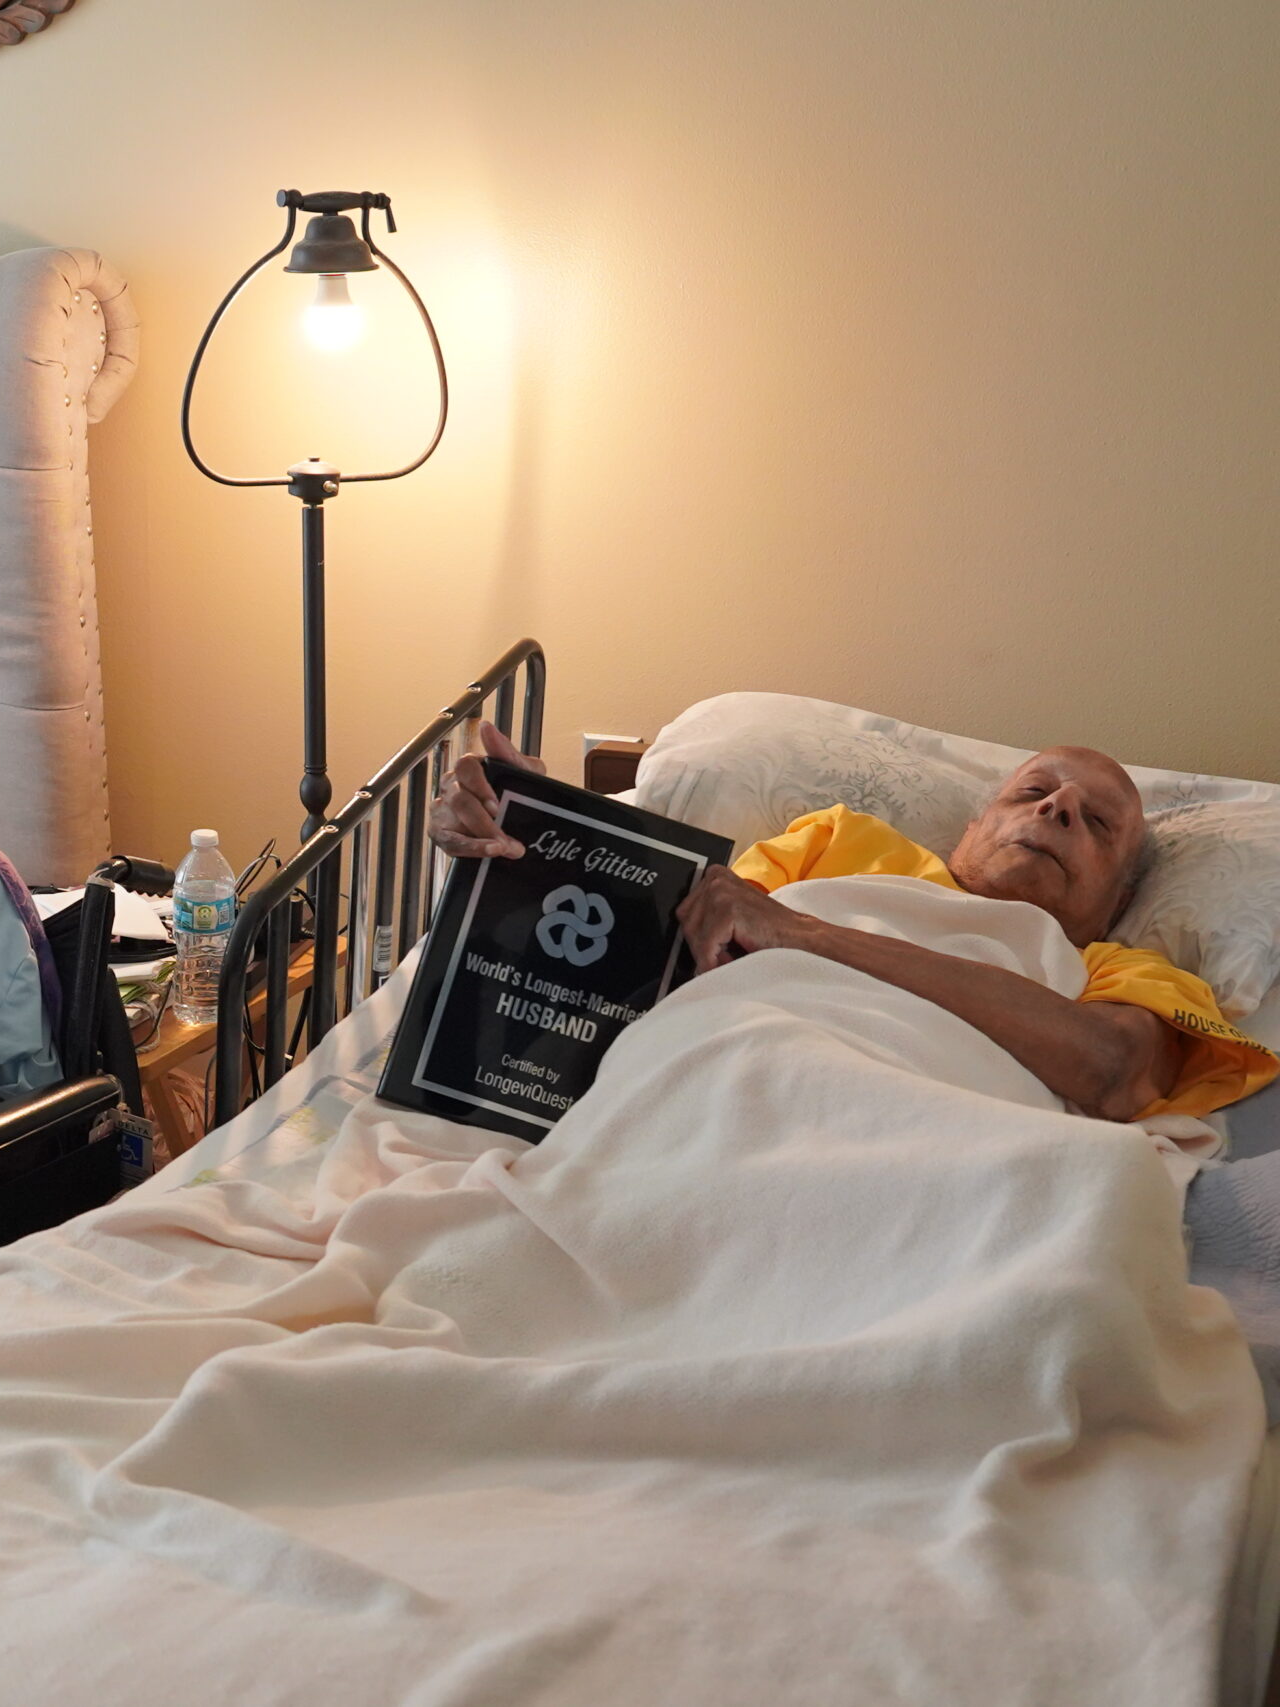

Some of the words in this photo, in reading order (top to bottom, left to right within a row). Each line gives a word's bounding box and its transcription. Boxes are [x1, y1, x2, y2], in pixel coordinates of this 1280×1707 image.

[529, 830, 581, 860] Lyle
[584, 847, 658, 887] Gittens
[465, 952, 522, 986] World's
[496, 992, 597, 1043] HUSBAND
[1174, 1009, 1228, 1036] HOUSE
[502, 1053, 545, 1077] Certified
[546, 1067, 560, 1084] by
[475, 1066, 574, 1111] LongeviQuest
